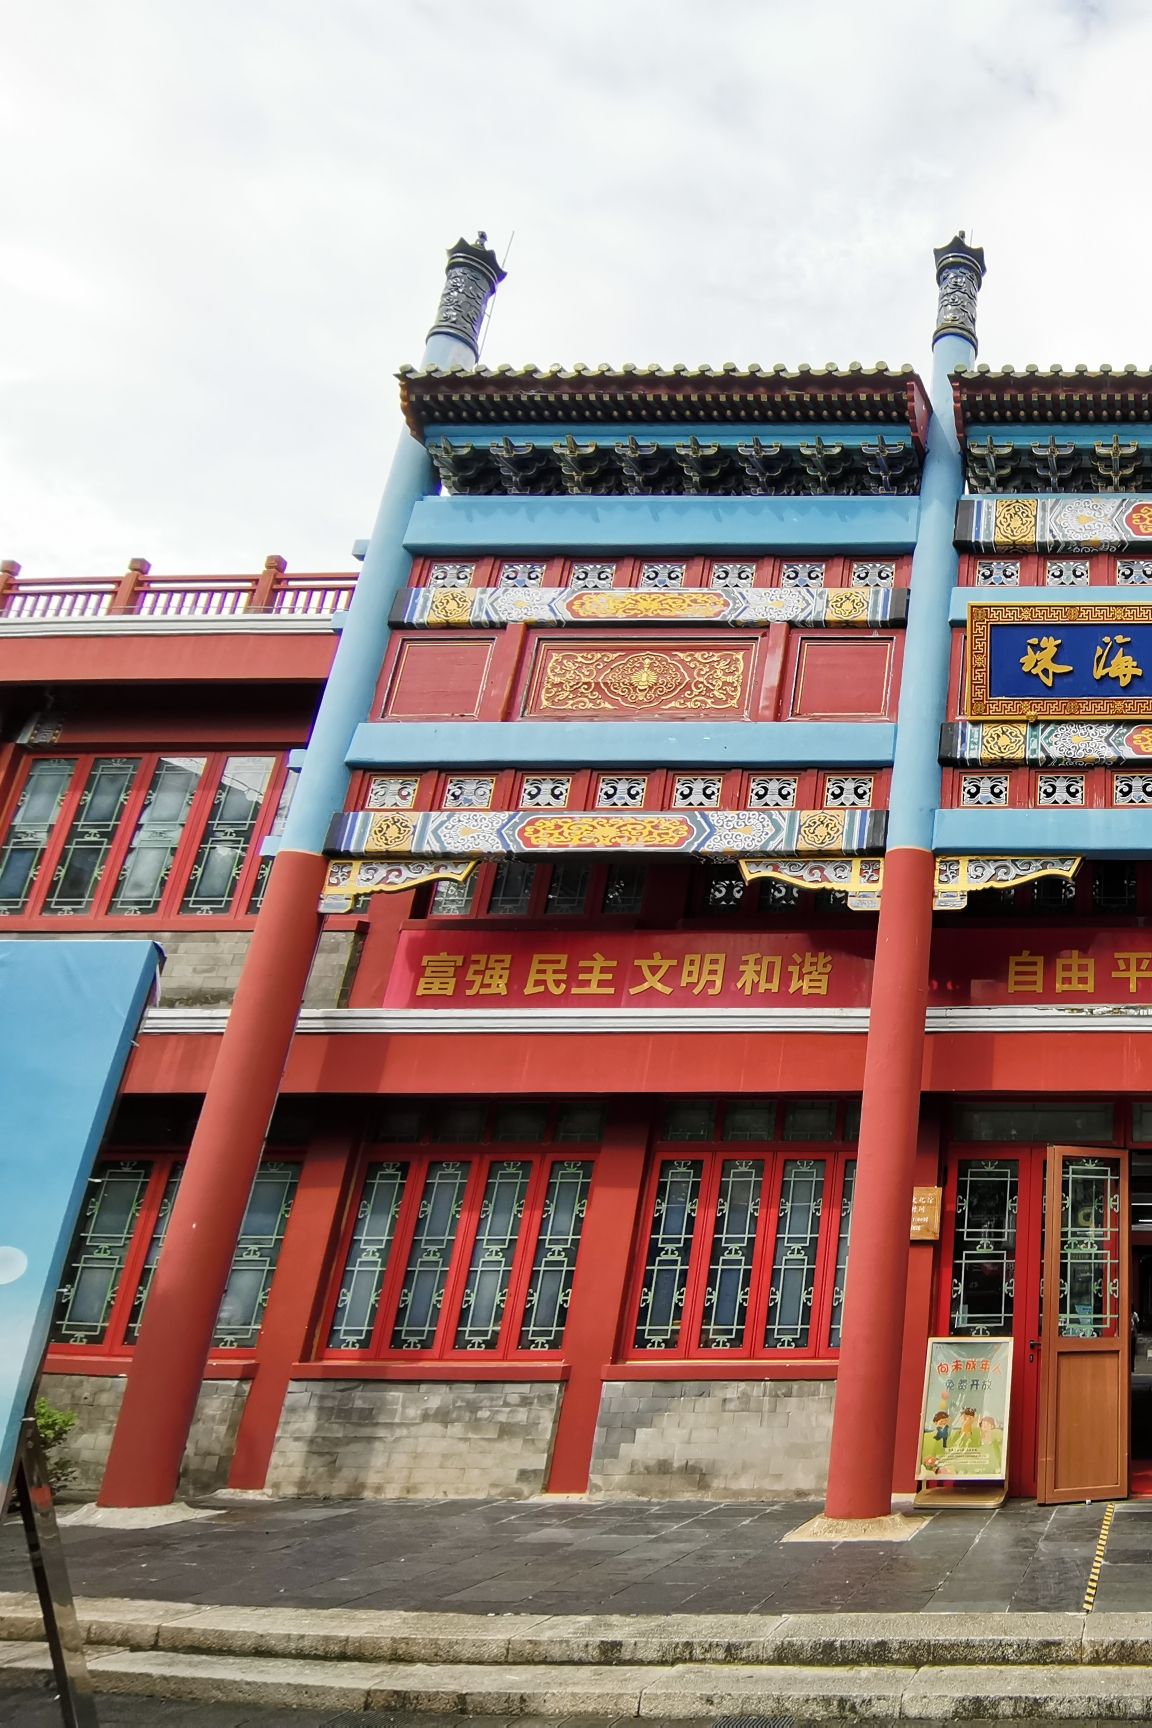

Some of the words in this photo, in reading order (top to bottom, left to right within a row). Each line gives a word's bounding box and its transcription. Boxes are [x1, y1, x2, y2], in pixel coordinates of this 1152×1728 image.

[415, 951, 833, 996] 富强民主文明和谐
